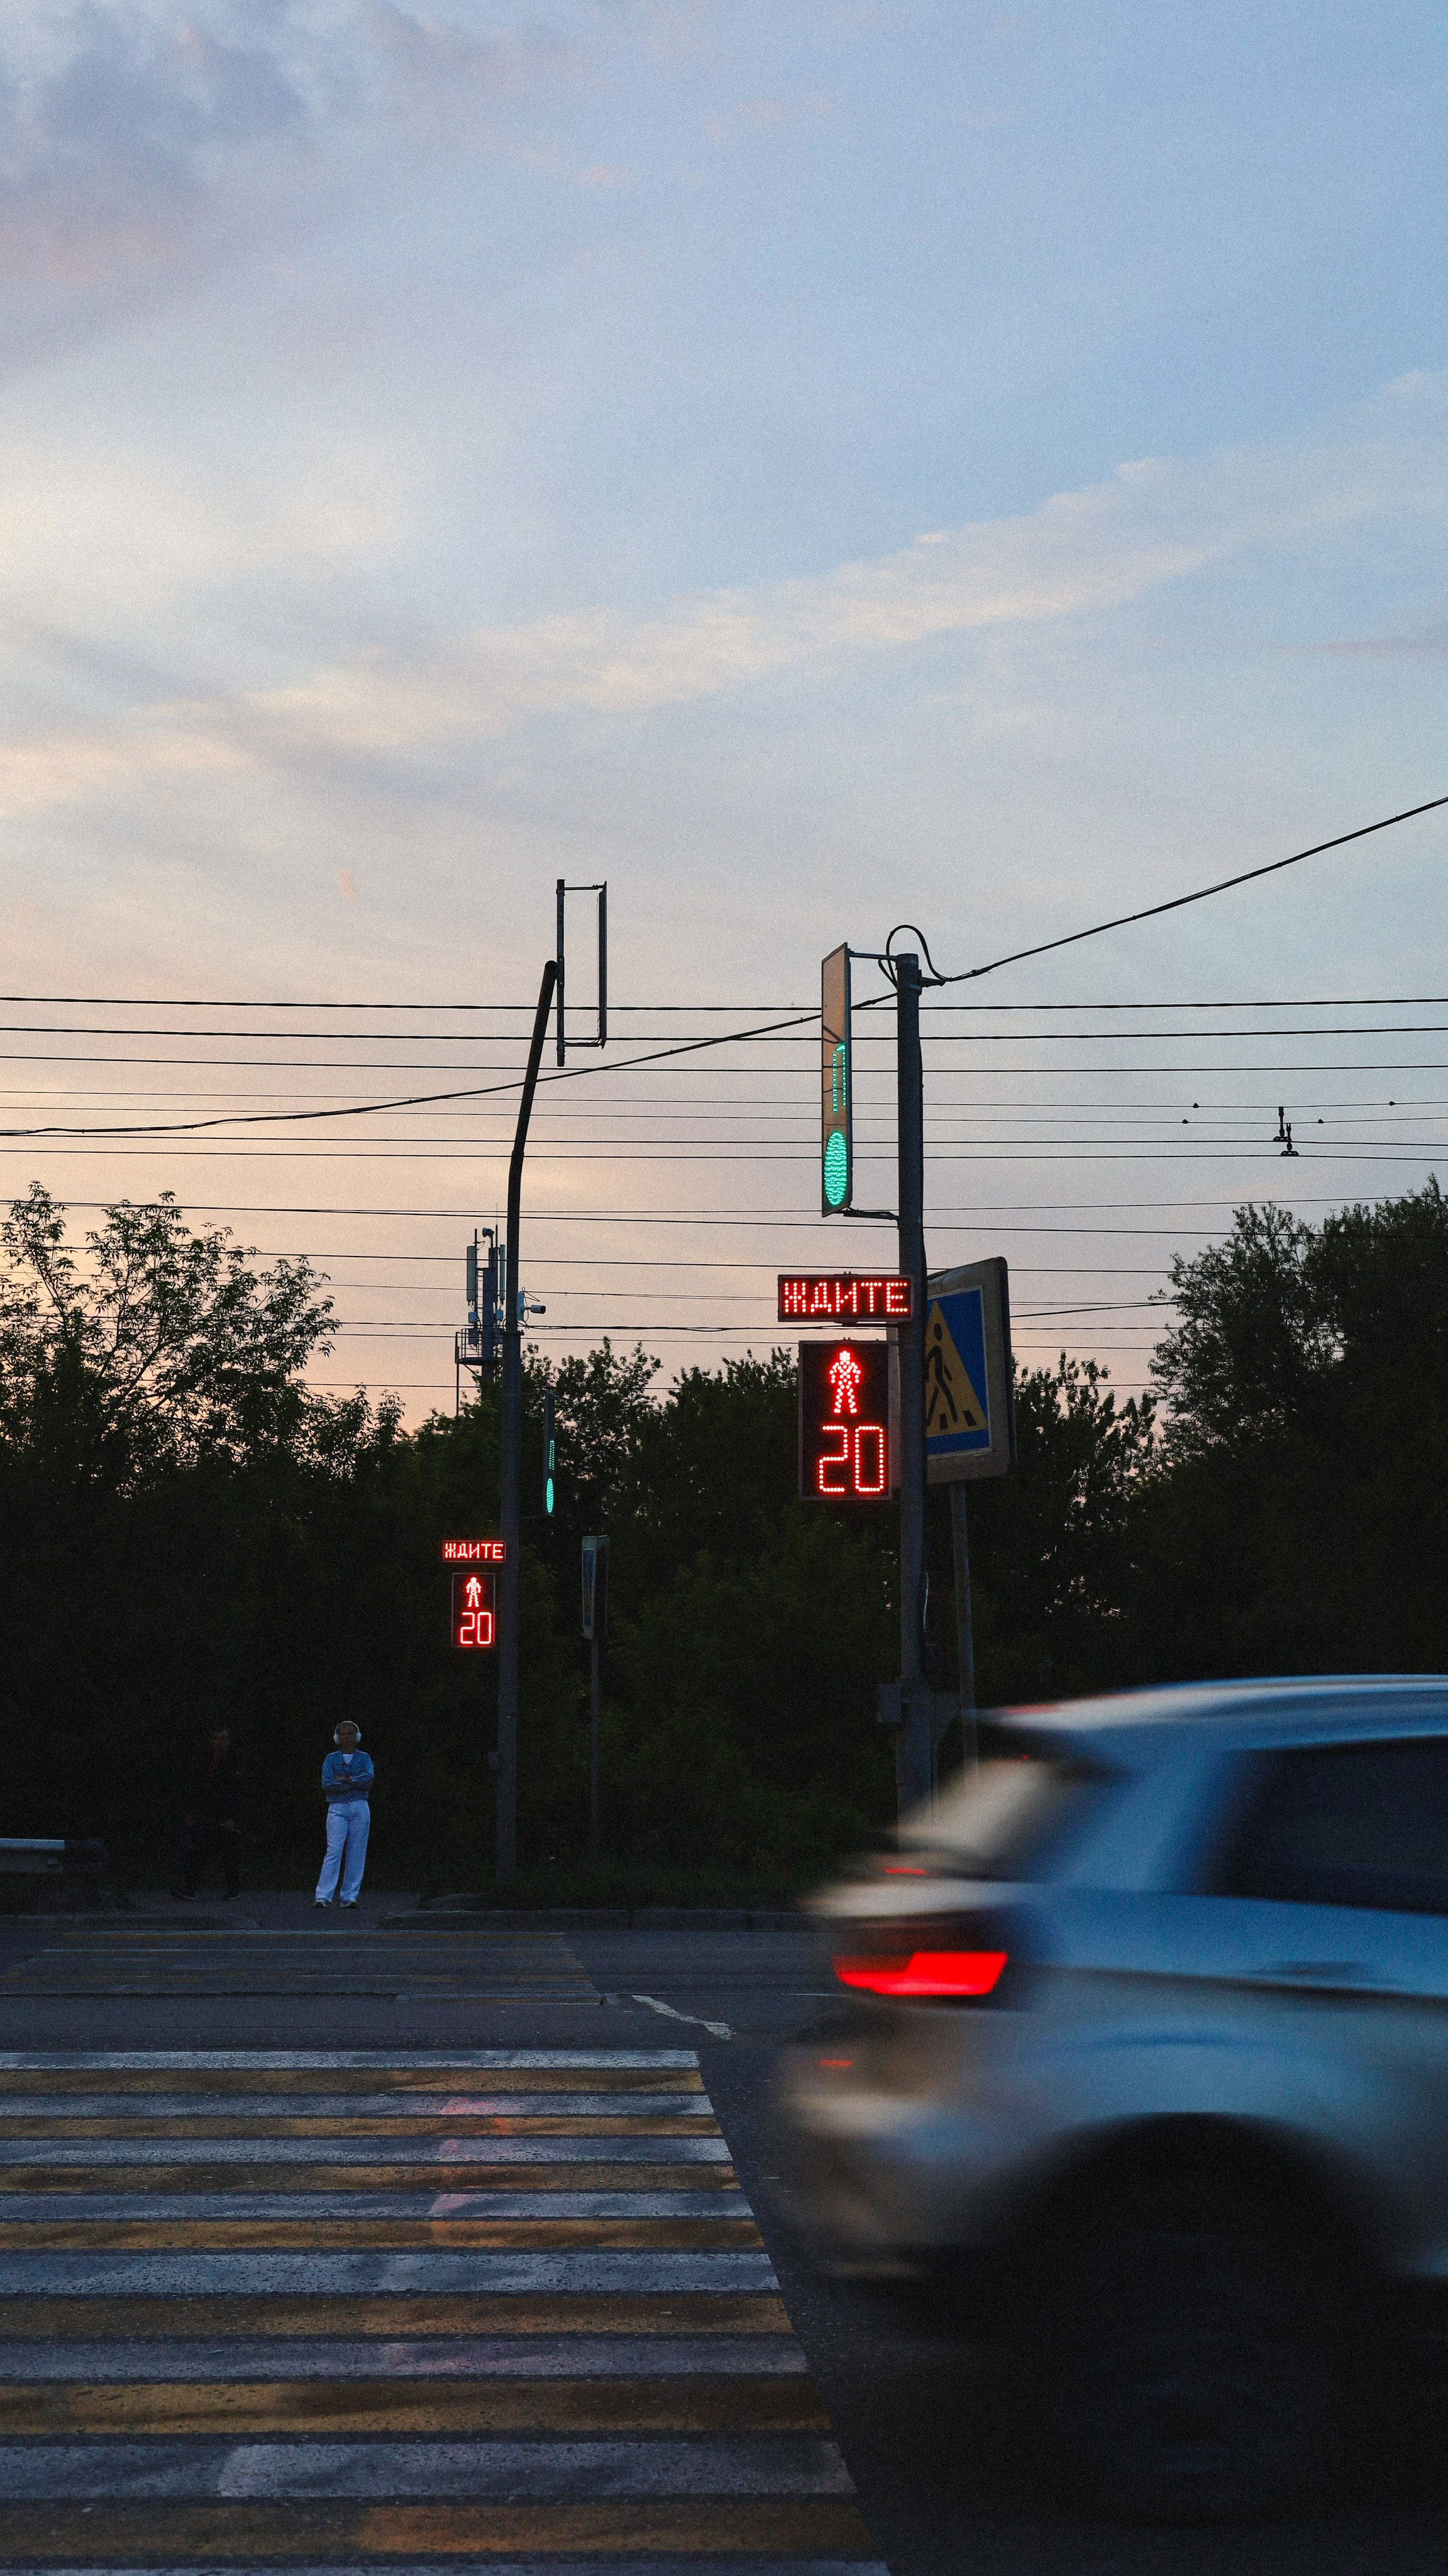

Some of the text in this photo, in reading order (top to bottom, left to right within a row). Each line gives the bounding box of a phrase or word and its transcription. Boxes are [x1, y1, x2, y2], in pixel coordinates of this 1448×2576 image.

[783, 1281, 909, 1314] ЖДИТЕ
[818, 1424, 885, 1493] 20
[444, 1542, 504, 1559] ЖДИТЕ
[460, 1611, 492, 1645] 20
